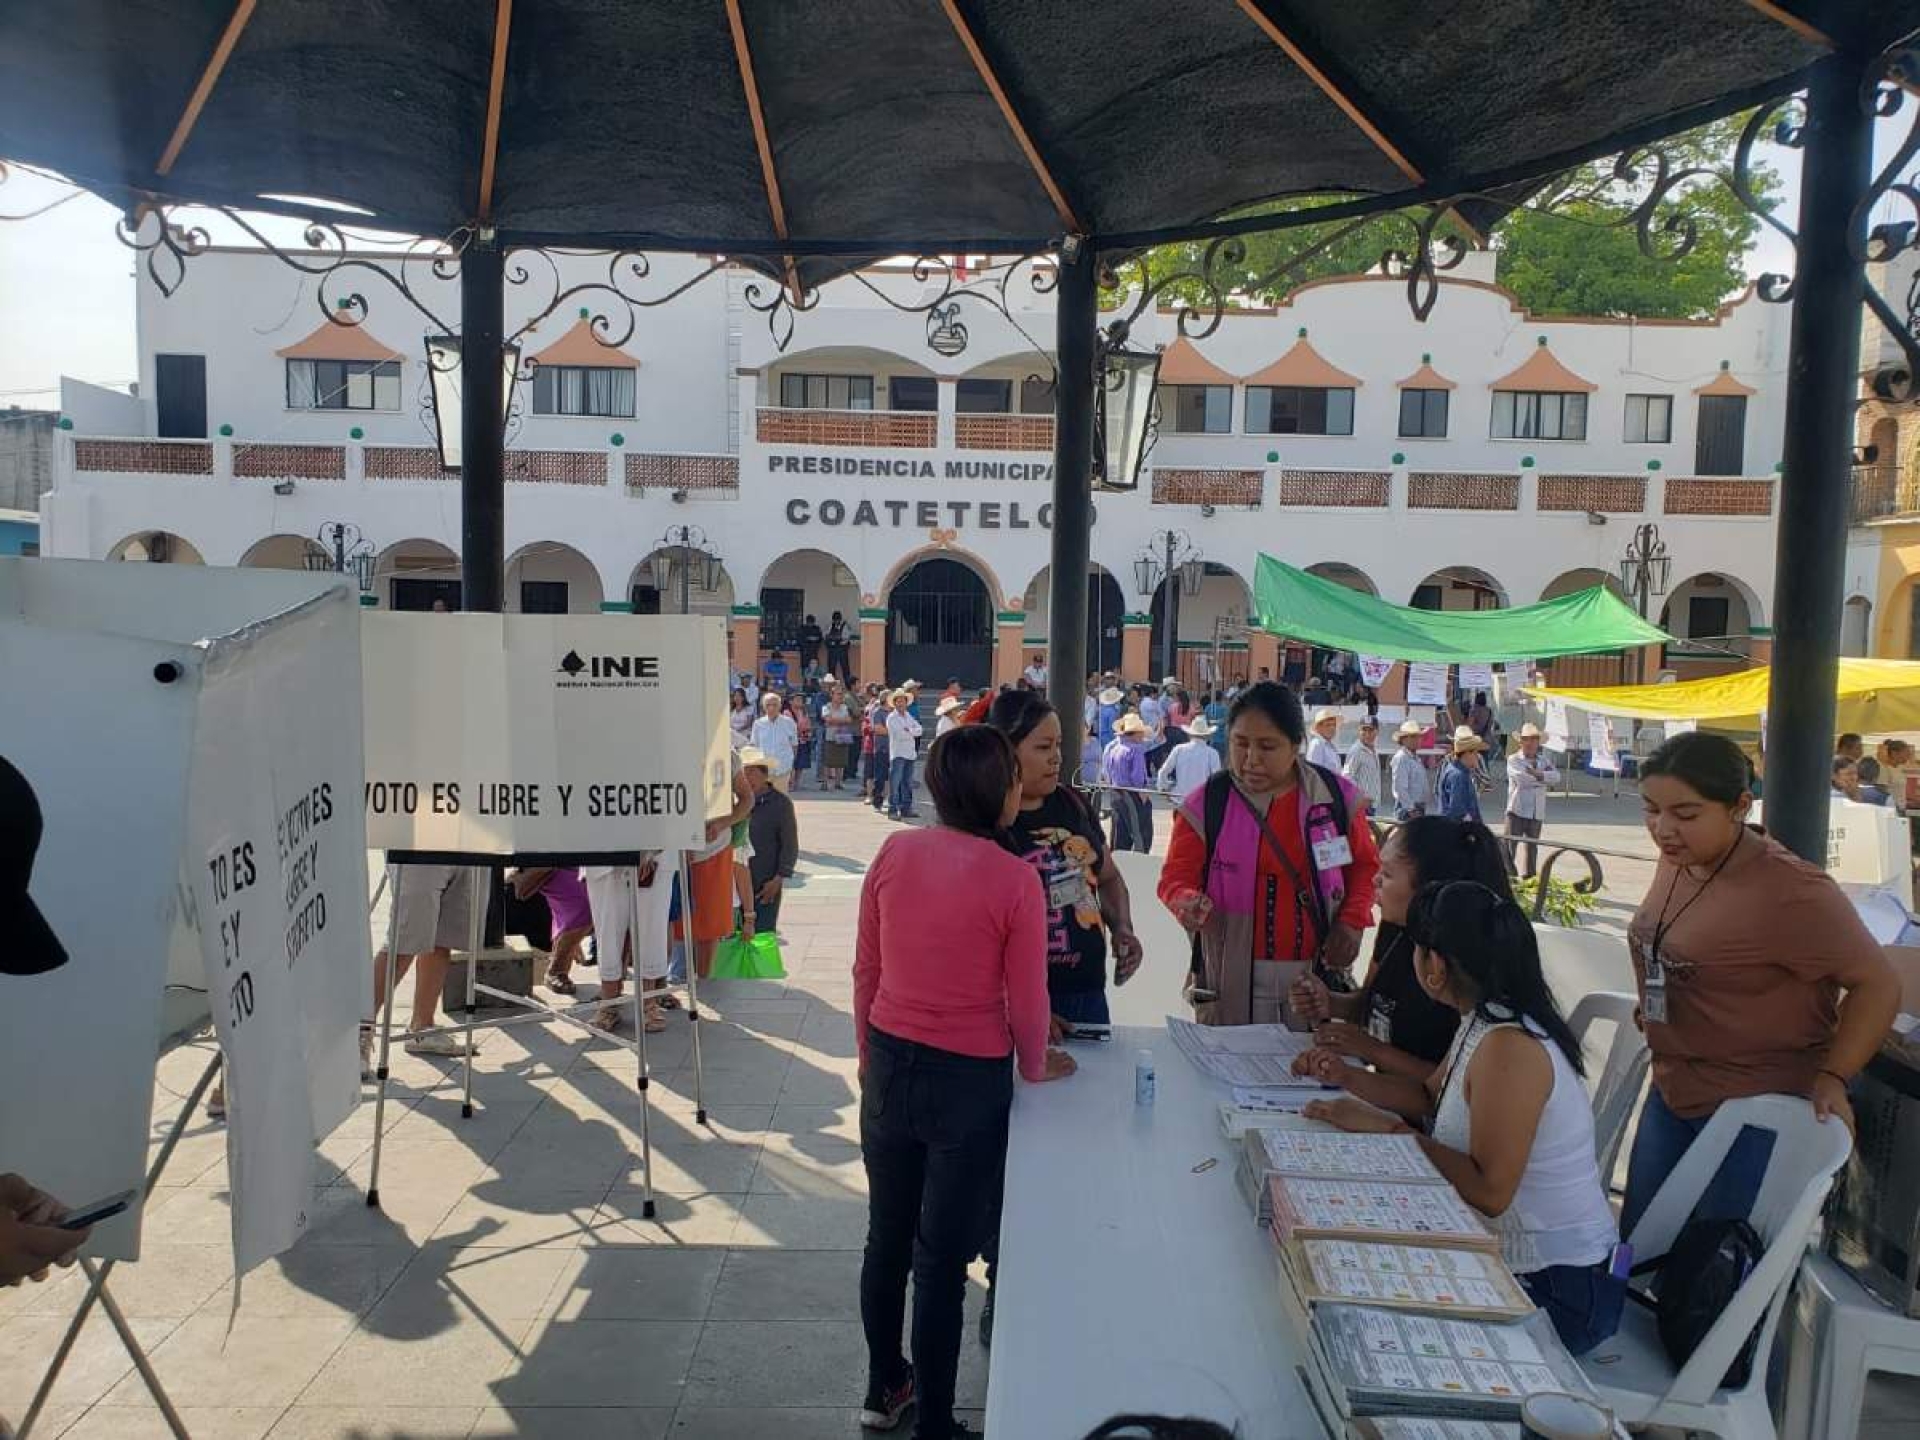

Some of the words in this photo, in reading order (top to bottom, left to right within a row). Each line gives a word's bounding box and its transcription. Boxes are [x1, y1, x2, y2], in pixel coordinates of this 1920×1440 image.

[768, 455, 935, 478] PRESIDENCIA
[945, 461, 1054, 482] MUNICIP
[785, 498, 1097, 530] COATETELC
[591, 657, 659, 678] INE
[313, 782, 333, 825] ES
[432, 782, 461, 814] ES
[479, 784, 540, 817] LIBRE
[557, 785, 573, 817] Y
[588, 783, 688, 817] SECRETO
[232, 841, 257, 892] ES
[309, 839, 318, 881] Y
[229, 909, 241, 960] Y
